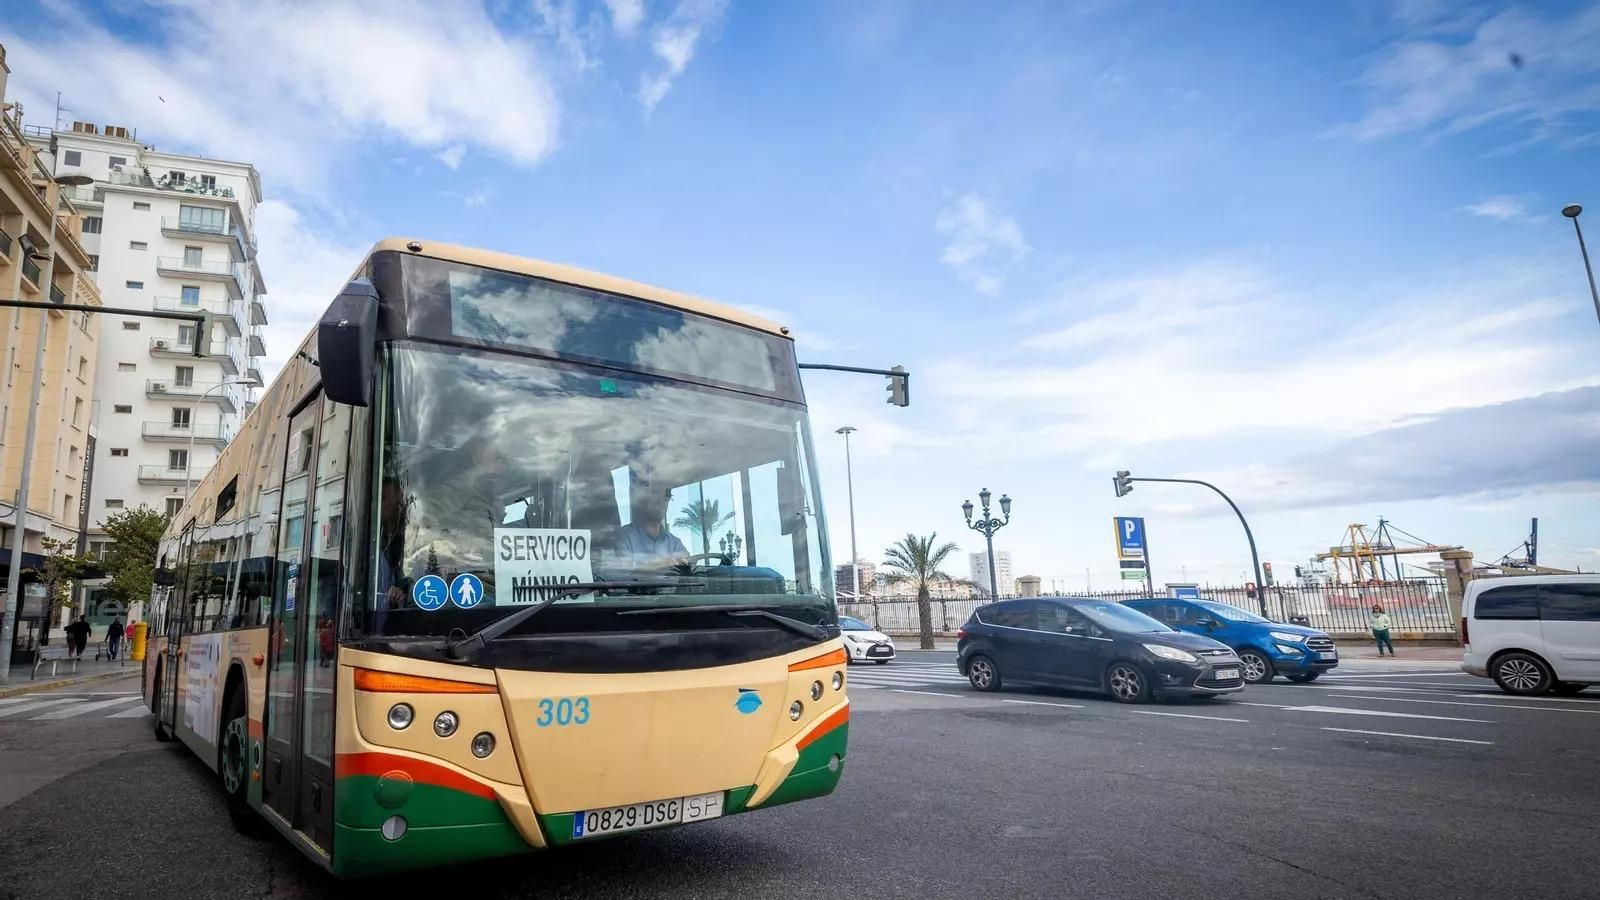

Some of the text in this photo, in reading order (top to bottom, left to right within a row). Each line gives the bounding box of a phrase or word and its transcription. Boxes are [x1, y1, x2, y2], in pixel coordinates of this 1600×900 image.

[1124, 519, 1136, 540] P
[501, 535, 586, 561] SERVICIO
[537, 697, 590, 727] 303
[588, 806, 637, 832] 0829
[643, 800, 678, 825] DSG
